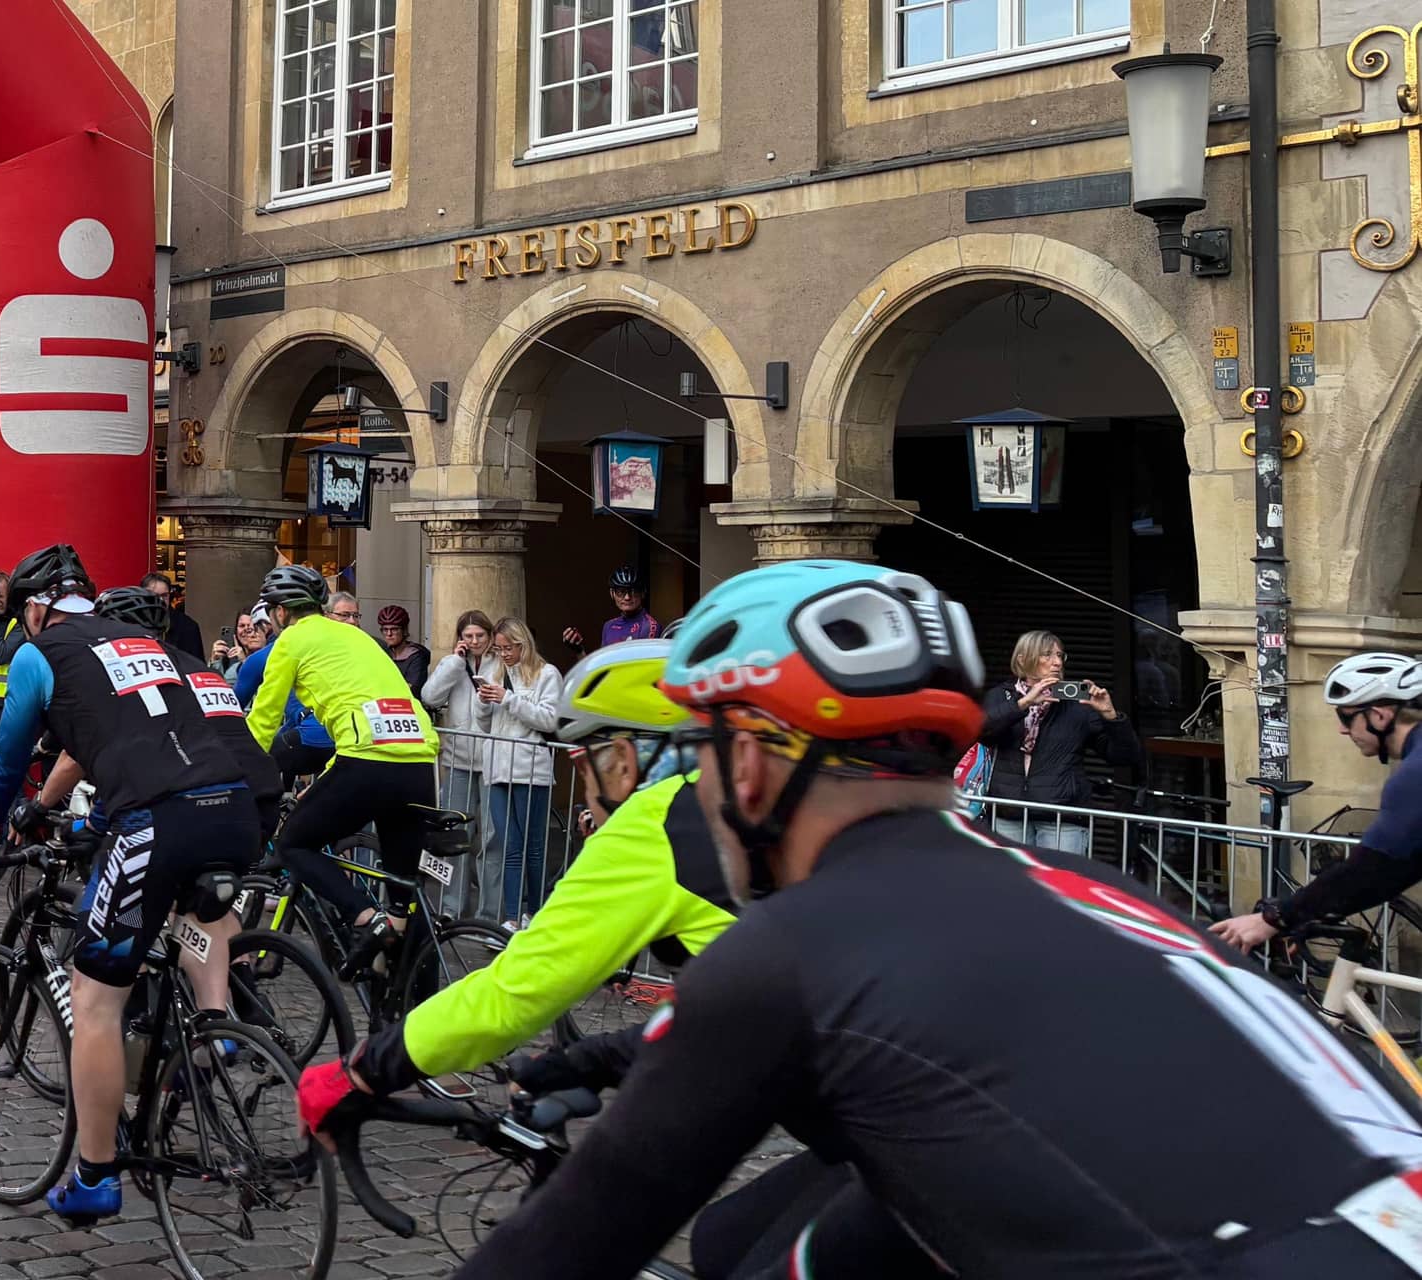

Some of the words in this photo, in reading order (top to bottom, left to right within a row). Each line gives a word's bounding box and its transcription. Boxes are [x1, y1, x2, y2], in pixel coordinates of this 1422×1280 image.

[450, 201, 756, 284] FREISFELD
[215, 271, 279, 293] Prinzipalmarkt
[209, 343, 227, 366] 20
[113, 668, 125, 682] B
[128, 659, 175, 677] 1799
[201, 692, 238, 706] 1706
[374, 722, 382, 734] B
[384, 719, 420, 733] 1895
[428, 857, 450, 878] 1895
[179, 923, 208, 953] 1799
